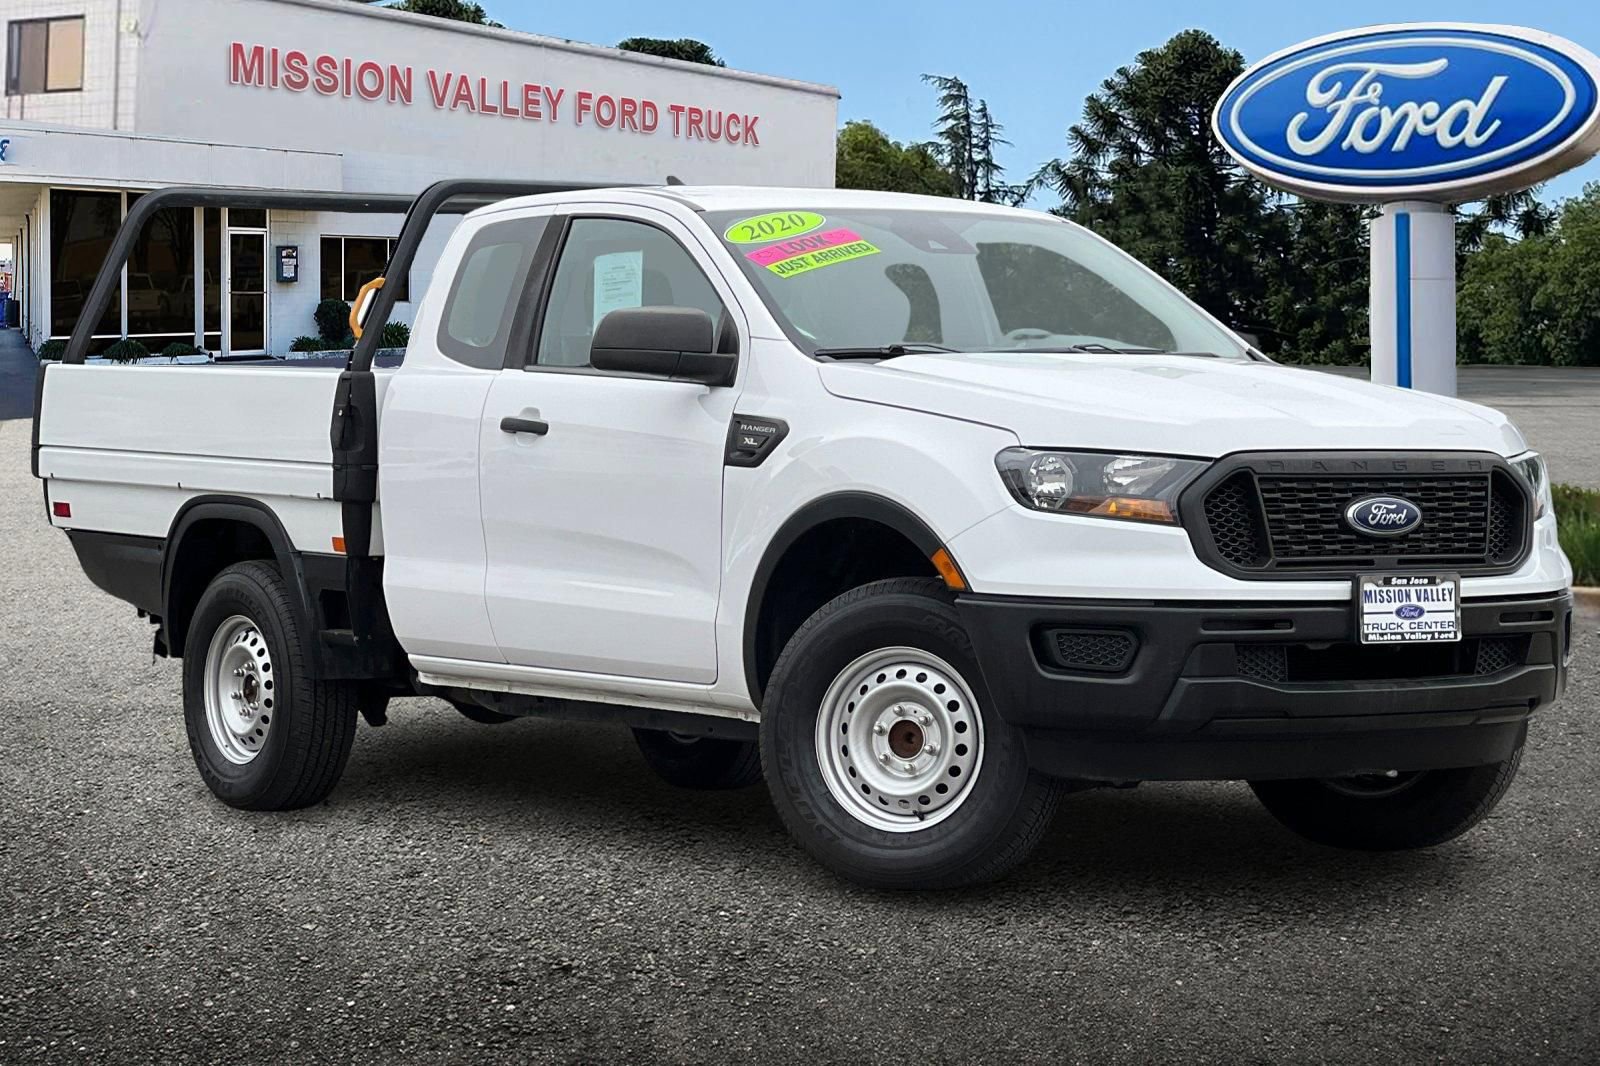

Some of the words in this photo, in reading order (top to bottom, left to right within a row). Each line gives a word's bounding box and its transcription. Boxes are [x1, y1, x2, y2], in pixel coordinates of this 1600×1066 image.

[230, 41, 413, 104] MISSION
[427, 69, 564, 121] VALLEY
[576, 90, 660, 134] FORD
[669, 103, 760, 146] TRUCK
[1286, 57, 1509, 156] Ford
[741, 213, 806, 241] 2020
[776, 235, 832, 255] LOOK
[777, 257, 810, 275] JUST
[811, 243, 872, 264] ARRIVED
[740, 424, 776, 433] RANGER
[743, 437, 758, 445] XL
[1267, 460, 1482, 472] RANGER
[1368, 503, 1407, 525] Ford
[1391, 577, 1408, 585] San
[1364, 588, 1411, 604] MISSION
[1415, 587, 1454, 602] VALLEY
[1400, 606, 1420, 618] Ford
[1364, 622, 1404, 632] TRUCK
[1409, 621, 1456, 630] CENTER
[1368, 633, 1402, 641] Mission
[1404, 632, 1433, 641] Valley
[1434, 631, 1455, 640] Ford
